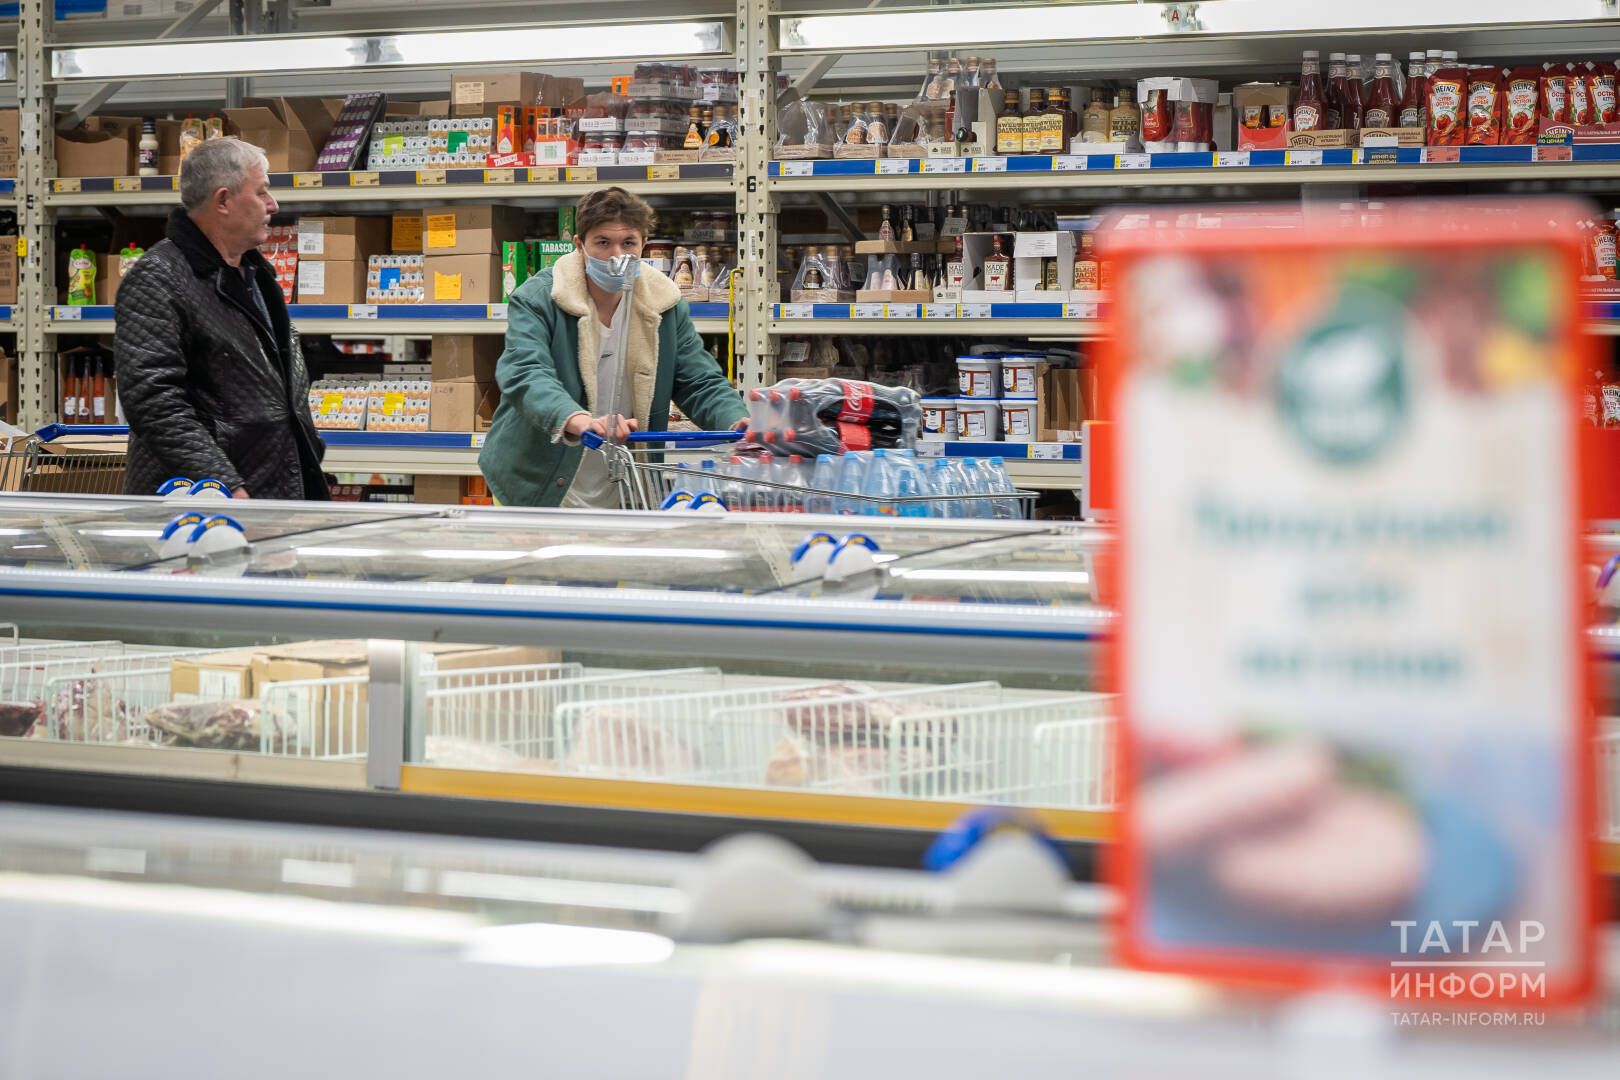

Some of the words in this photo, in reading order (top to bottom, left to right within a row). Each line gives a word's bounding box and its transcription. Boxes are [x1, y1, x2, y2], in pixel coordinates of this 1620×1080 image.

[1435, 84, 1456, 93] HEINZ
[1513, 82, 1533, 91] HEINZ
[1293, 136, 1312, 147] HEINZ
[747, 176, 756, 192] 6
[542, 243, 573, 252] TABASCO
